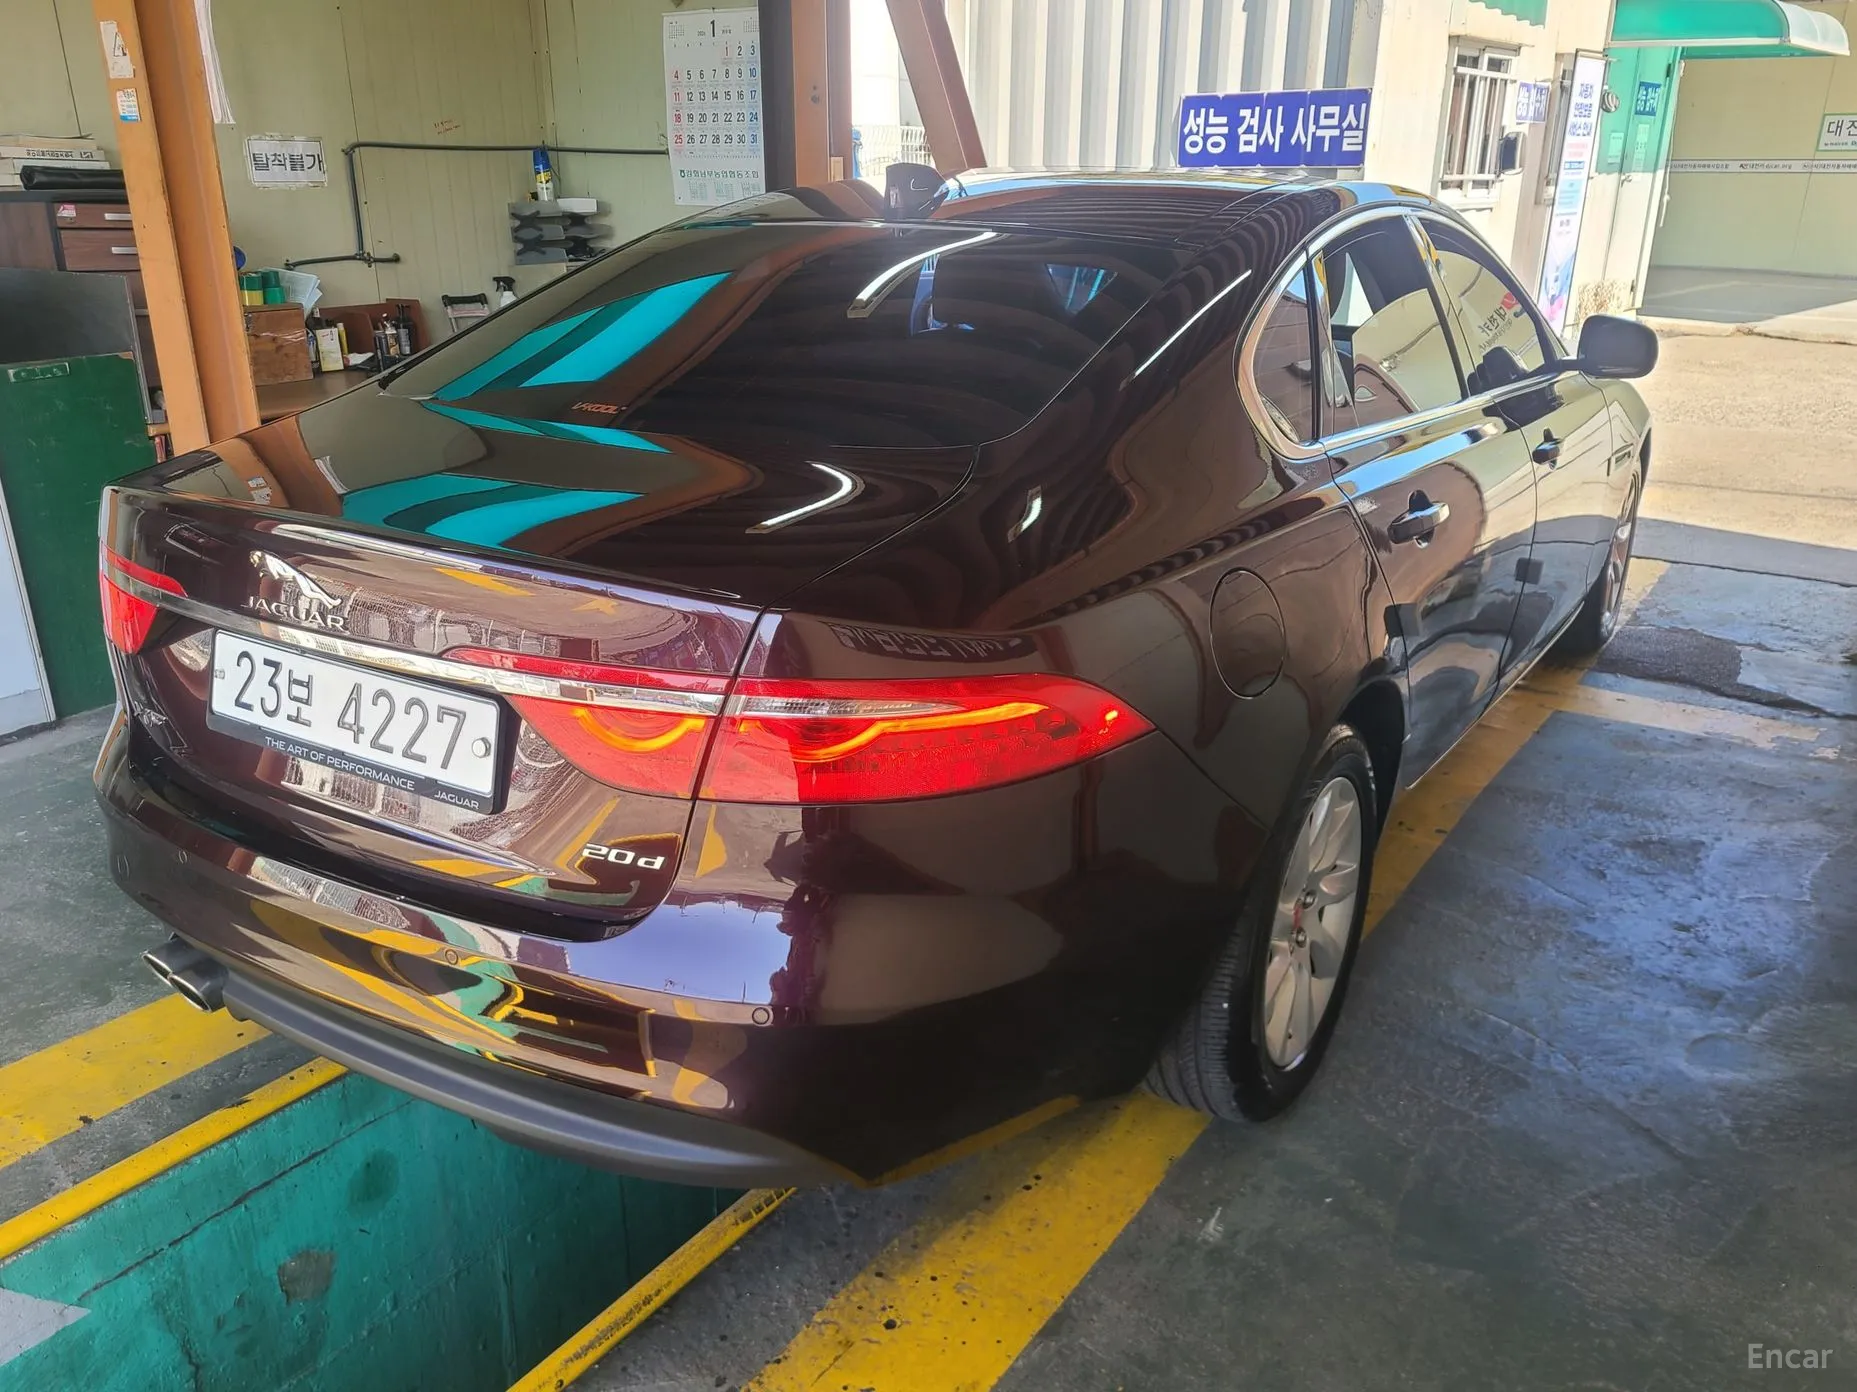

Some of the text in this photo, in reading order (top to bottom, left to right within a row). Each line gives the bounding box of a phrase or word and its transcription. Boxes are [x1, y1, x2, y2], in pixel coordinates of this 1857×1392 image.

[710, 19, 716, 37] 1
[725, 45, 755, 57] 1 2 3
[674, 68, 756, 80] 4 5 6 7 8 9 10
[674, 90, 757, 102] 11 12 13 14 15 16 17
[674, 112, 758, 123] 18 19 20 21 22 23 24
[1183, 103, 1367, 154] 성능 검사 사무실
[674, 134, 758, 144] 25 26 27 28 29 30 31
[252, 152, 323, 172] 탈착불가
[243, 595, 346, 631] JAGUAR
[234, 650, 467, 771] 23보 4227
[264, 736, 415, 790] THE ART OF PERFORMANCE
[434, 790, 480, 810] JAGUAR
[581, 842, 665, 871] 20d
